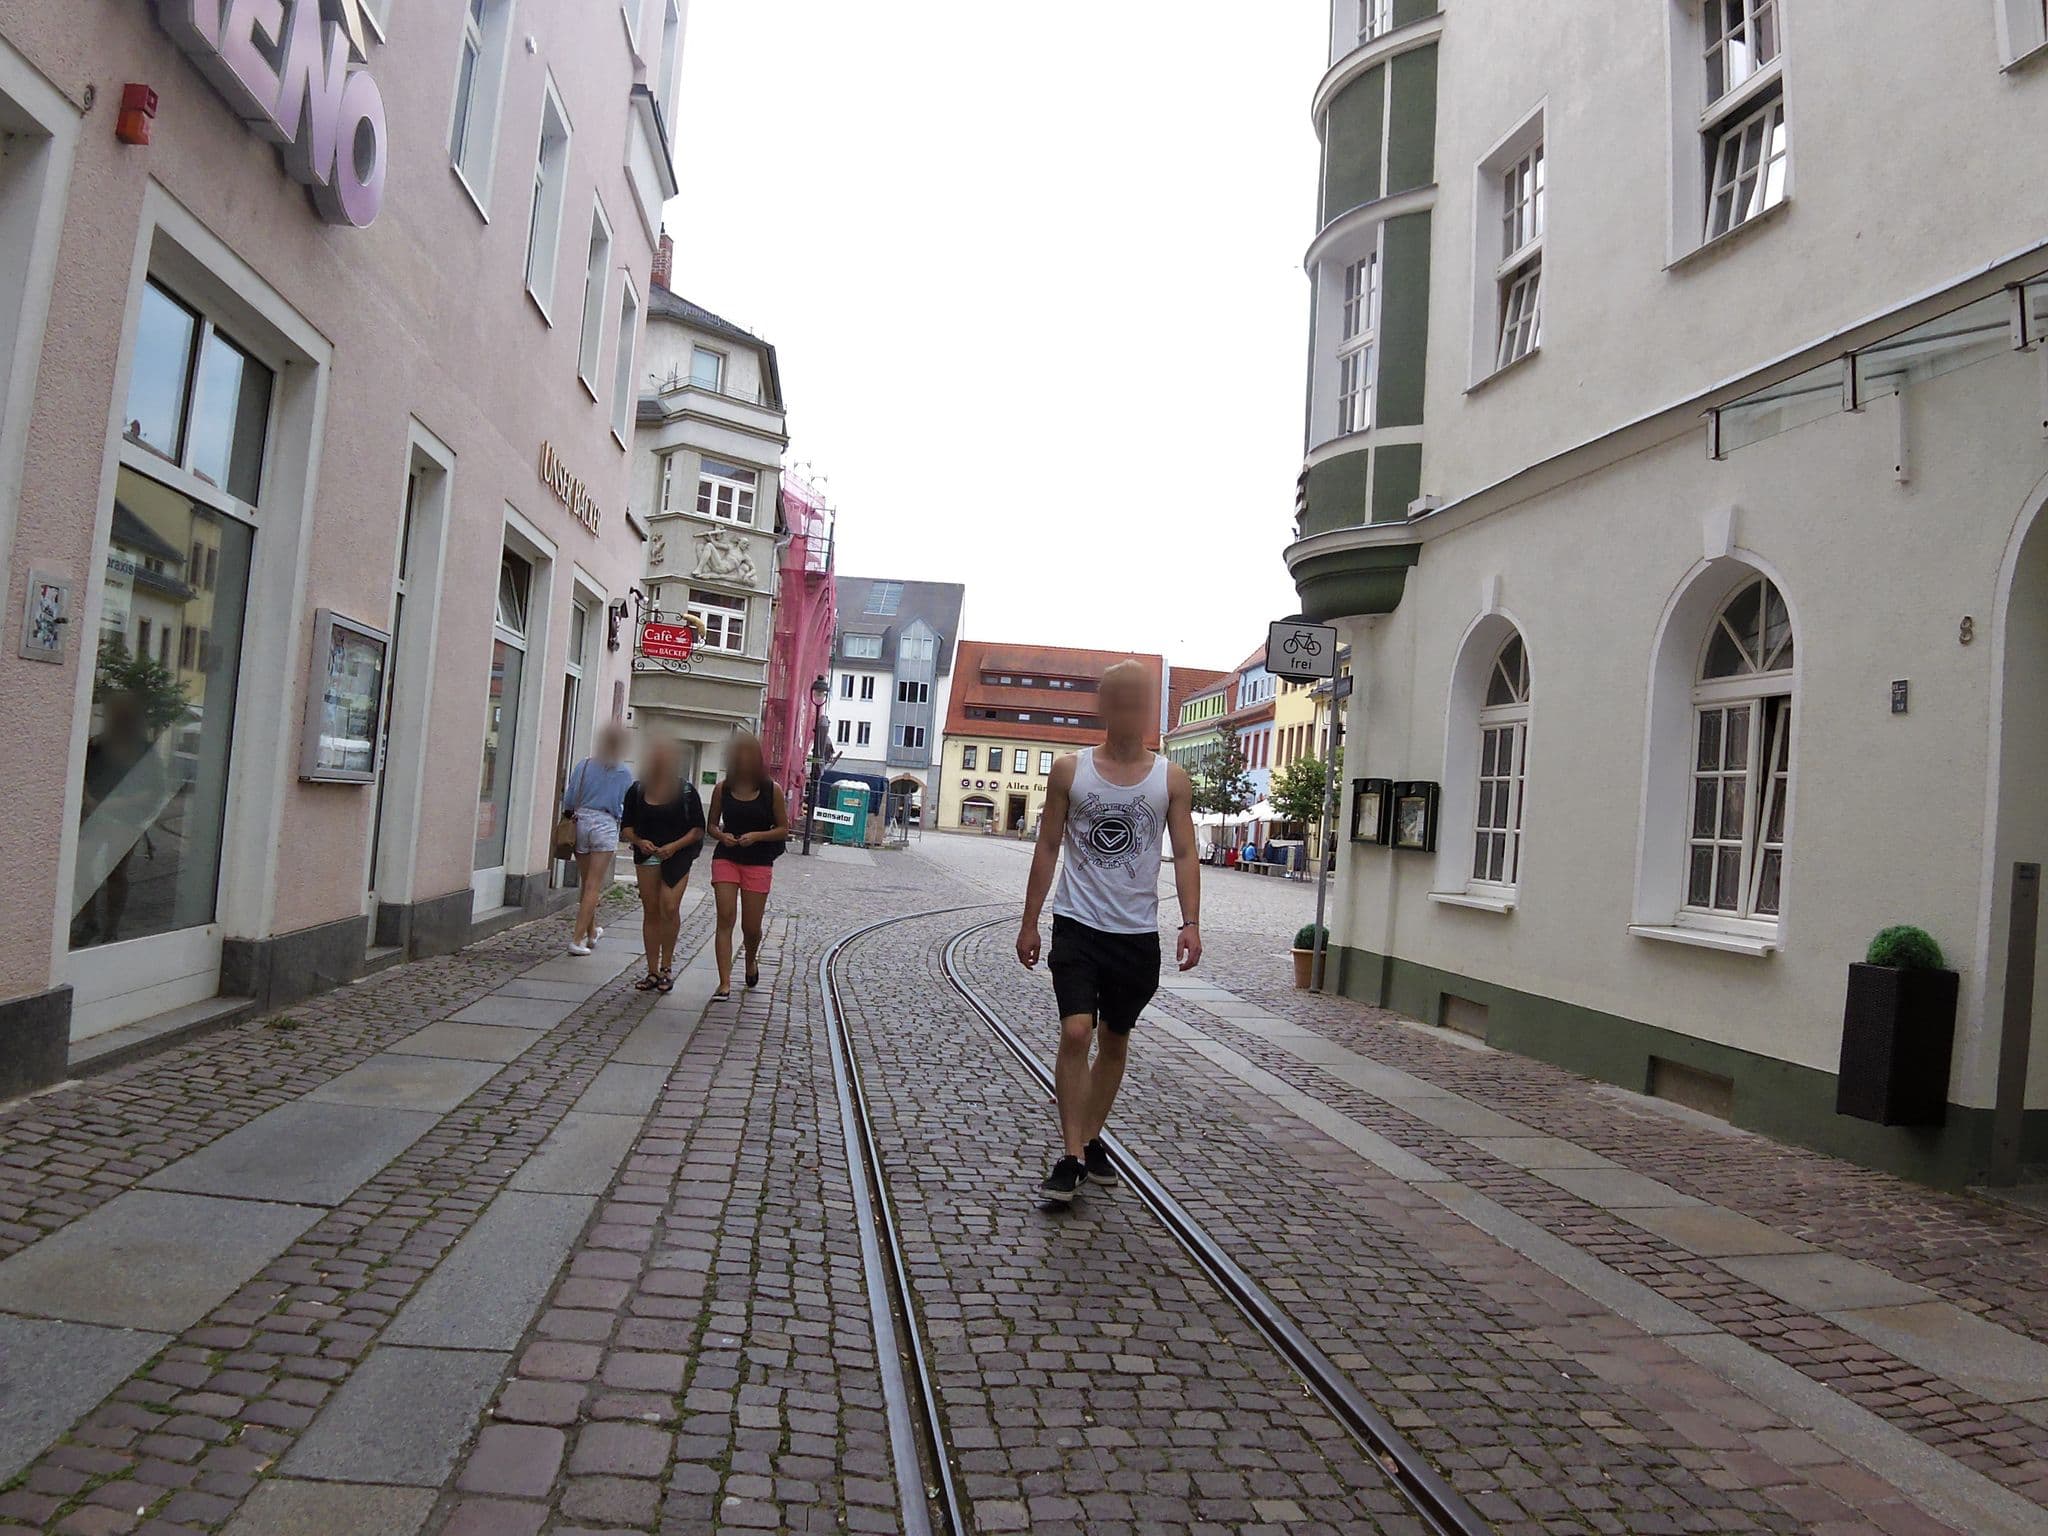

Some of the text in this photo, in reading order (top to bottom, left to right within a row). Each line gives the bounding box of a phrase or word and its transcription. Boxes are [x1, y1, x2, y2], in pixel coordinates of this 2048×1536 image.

[192, 0, 389, 229] ENO
[541, 440, 573, 508] UNSER
[1291, 657, 1312, 671] frei
[1006, 782, 1029, 791] Alles
